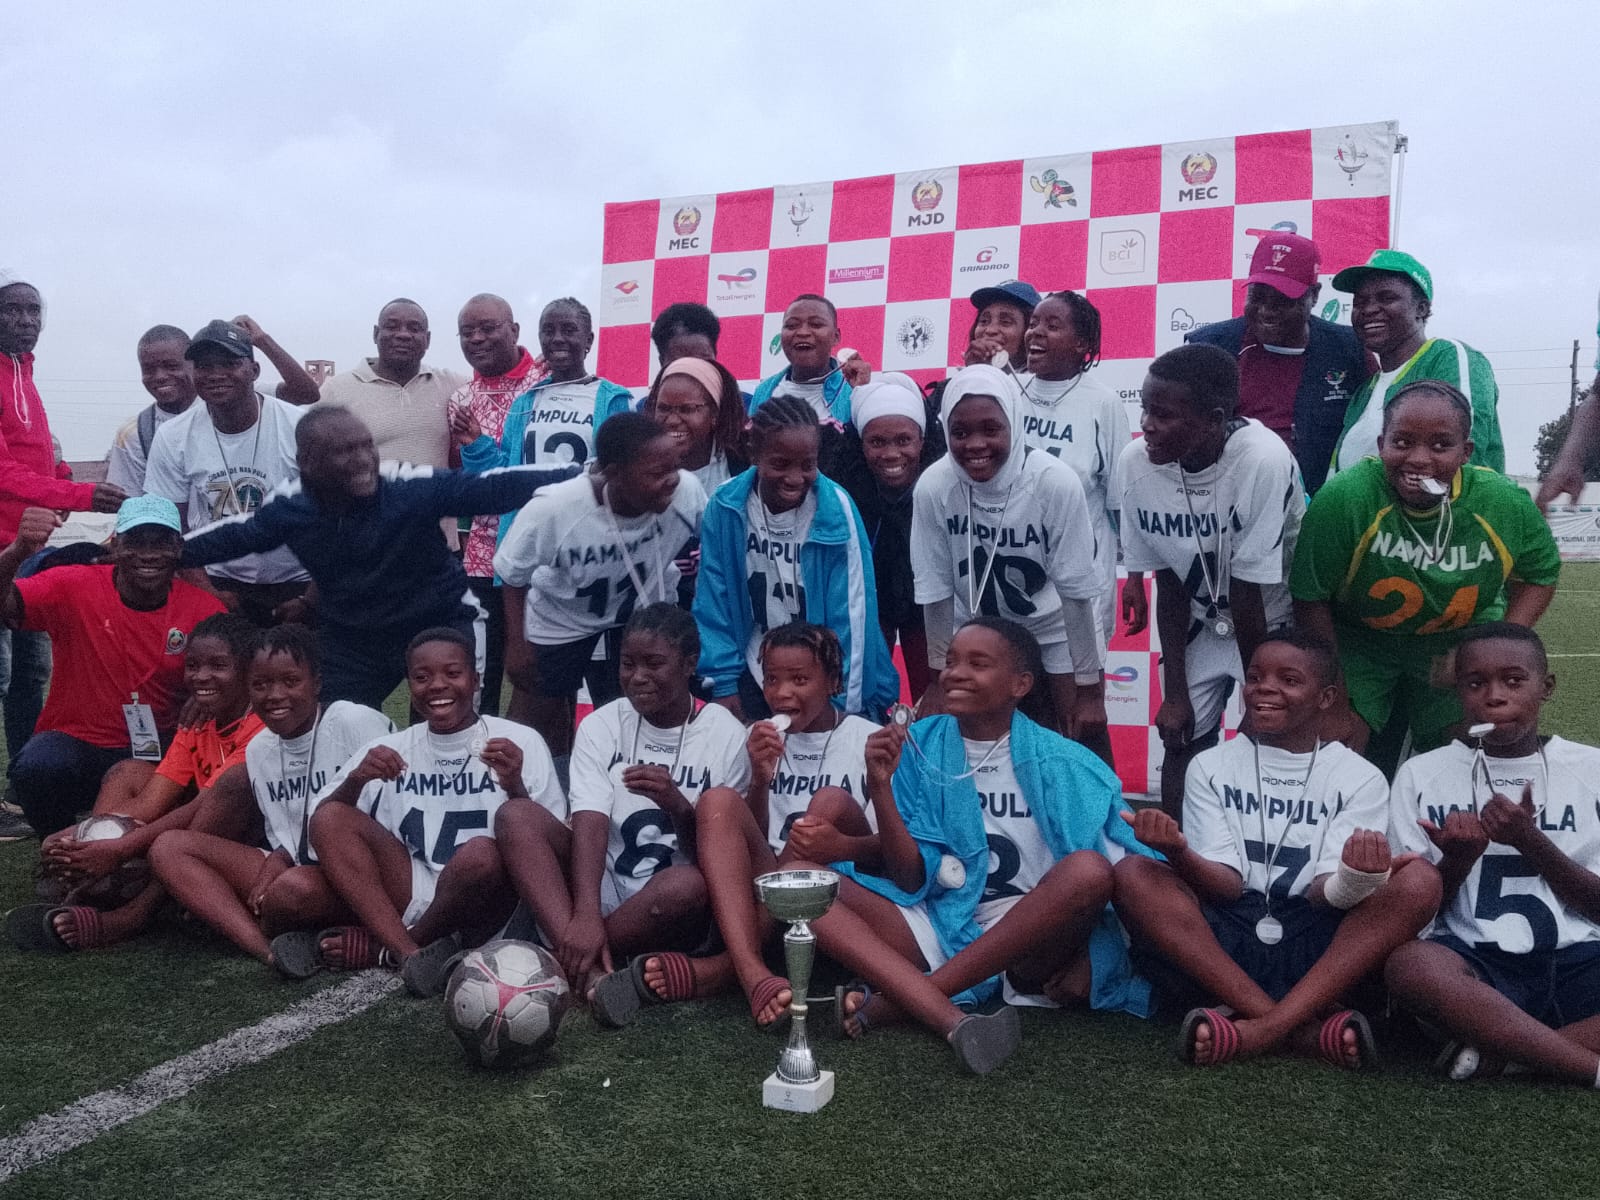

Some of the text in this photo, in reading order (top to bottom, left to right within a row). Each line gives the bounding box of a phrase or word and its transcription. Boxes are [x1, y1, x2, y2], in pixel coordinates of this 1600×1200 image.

[1178, 186, 1219, 202] MEC
[907, 212, 945, 228] MJD
[669, 237, 700, 251] MEC
[1109, 249, 1130, 261] BCI
[959, 263, 1010, 273] GRINDROD
[1115, 389, 1145, 399] GHT
[530, 409, 594, 427] AMPULA
[946, 513, 1041, 548] NAPULA
[1370, 530, 1494, 572] NAMPULA
[1104, 695, 1138, 703] Energies
[1261, 776, 1306, 787] RONEX
[1243, 839, 1311, 900] 7
[1474, 854, 1559, 956] 5
